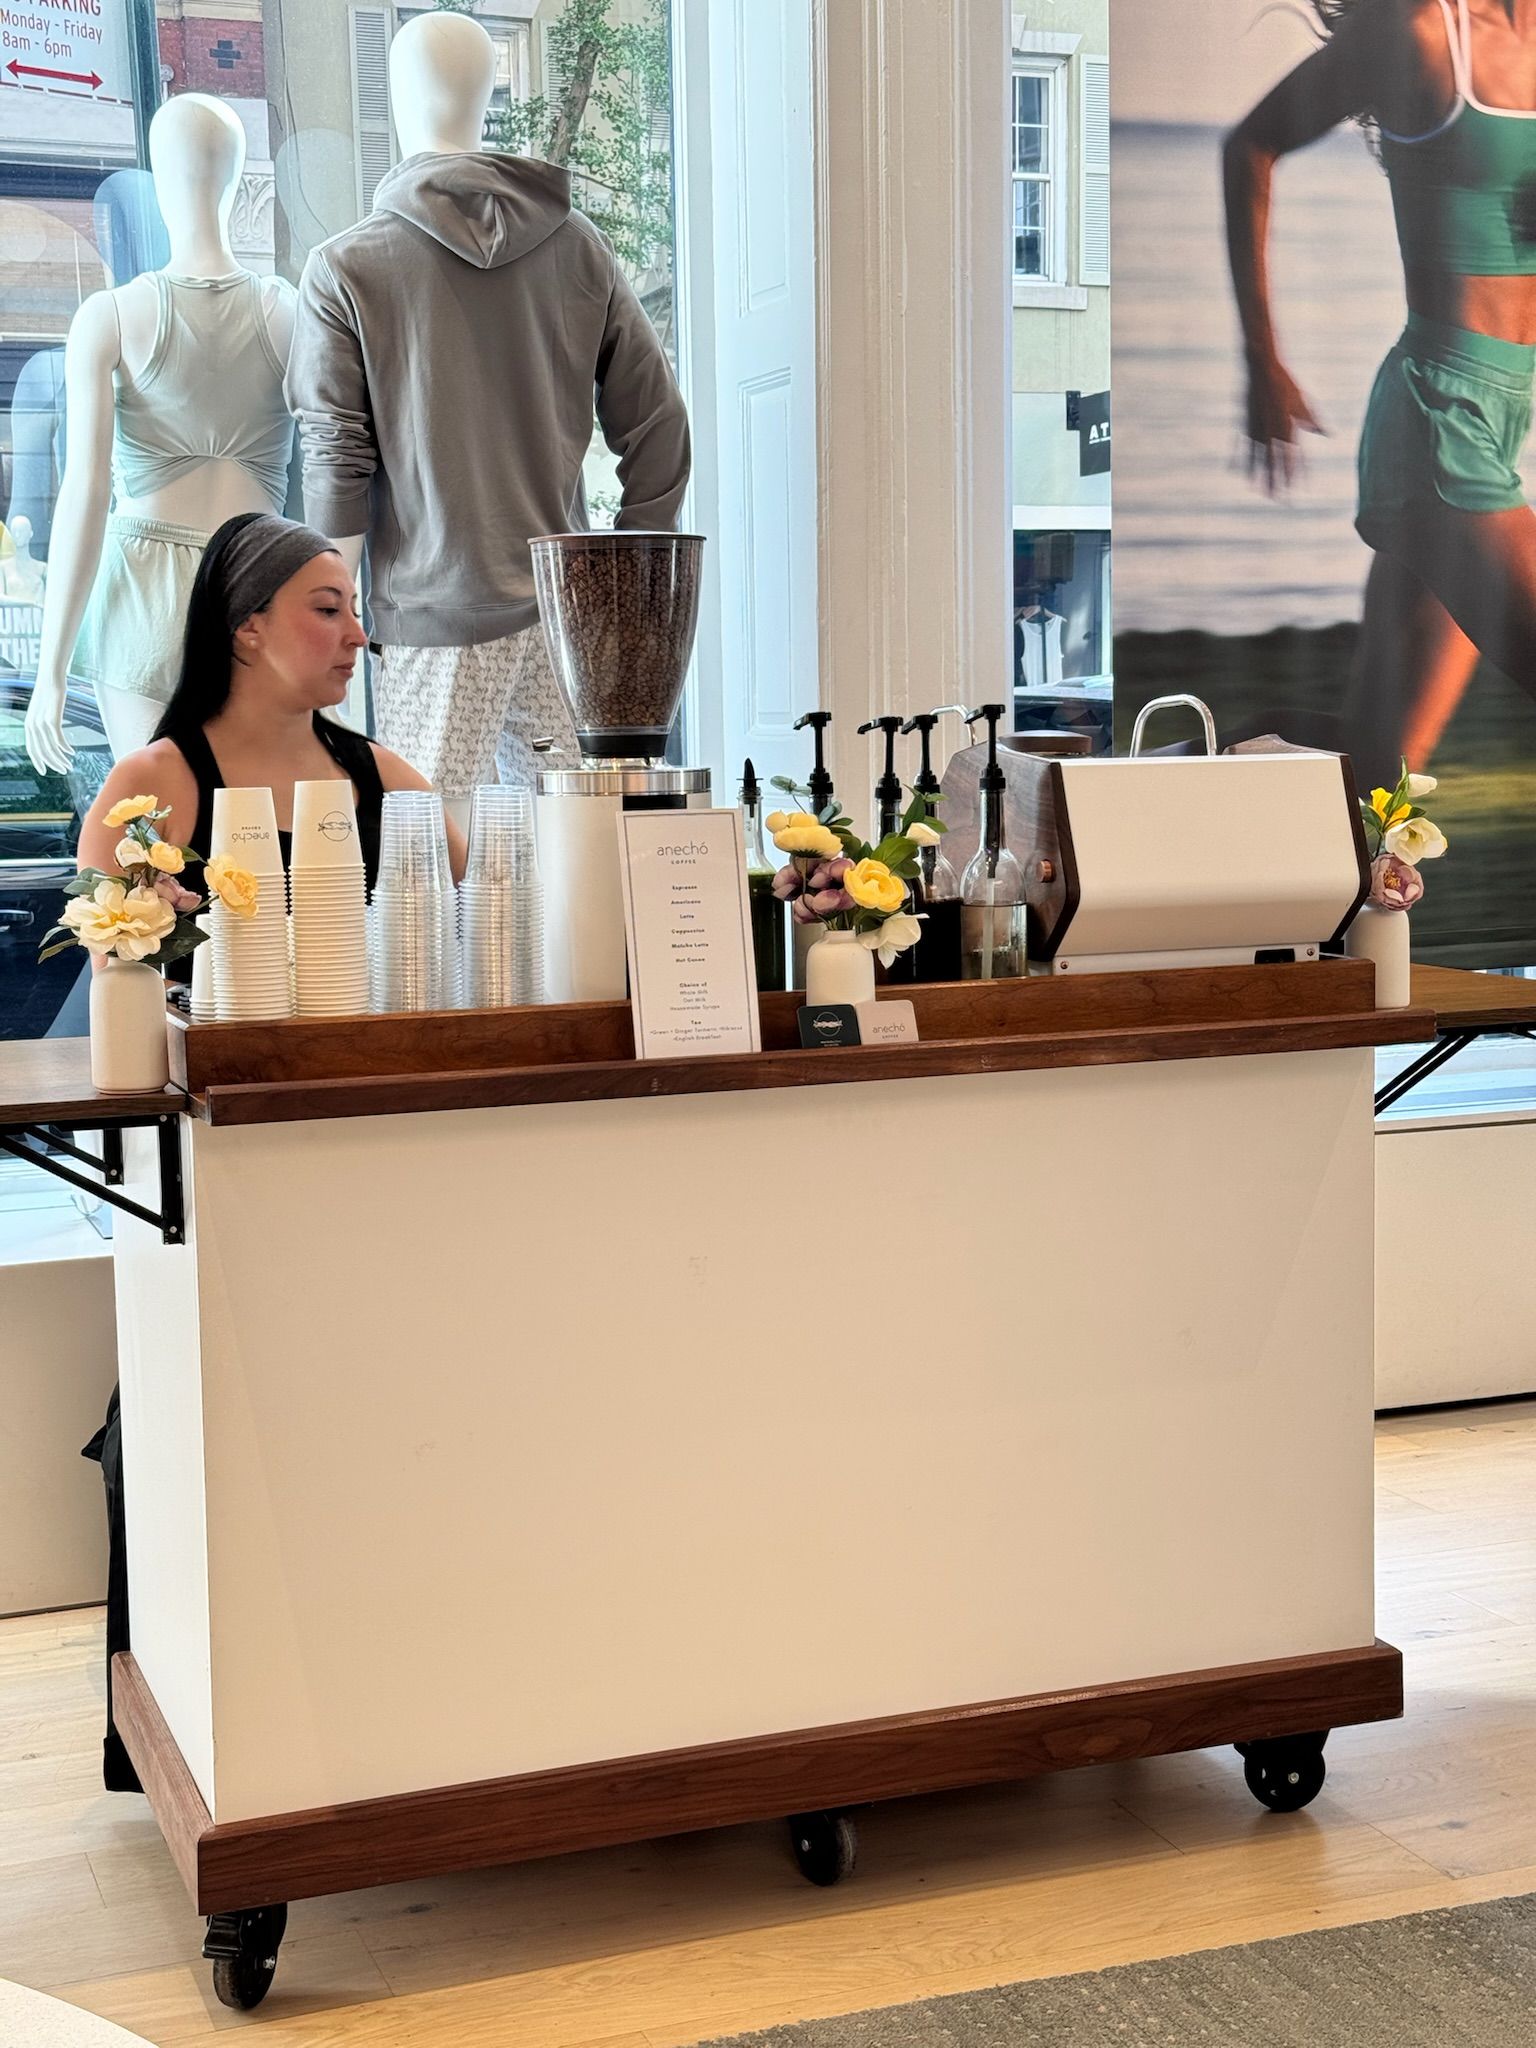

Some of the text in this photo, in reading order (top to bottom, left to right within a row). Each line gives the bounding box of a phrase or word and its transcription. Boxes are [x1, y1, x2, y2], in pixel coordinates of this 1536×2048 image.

[29, 0, 101, 16] KING
[0, 8, 50, 35] Monday
[64, 19, 102, 44] Friday
[2, 30, 31, 51] 8am
[44, 38, 72, 58] 6pm
[657, 840, 708, 856] anechó
[872, 1023, 905, 1033] anechó
